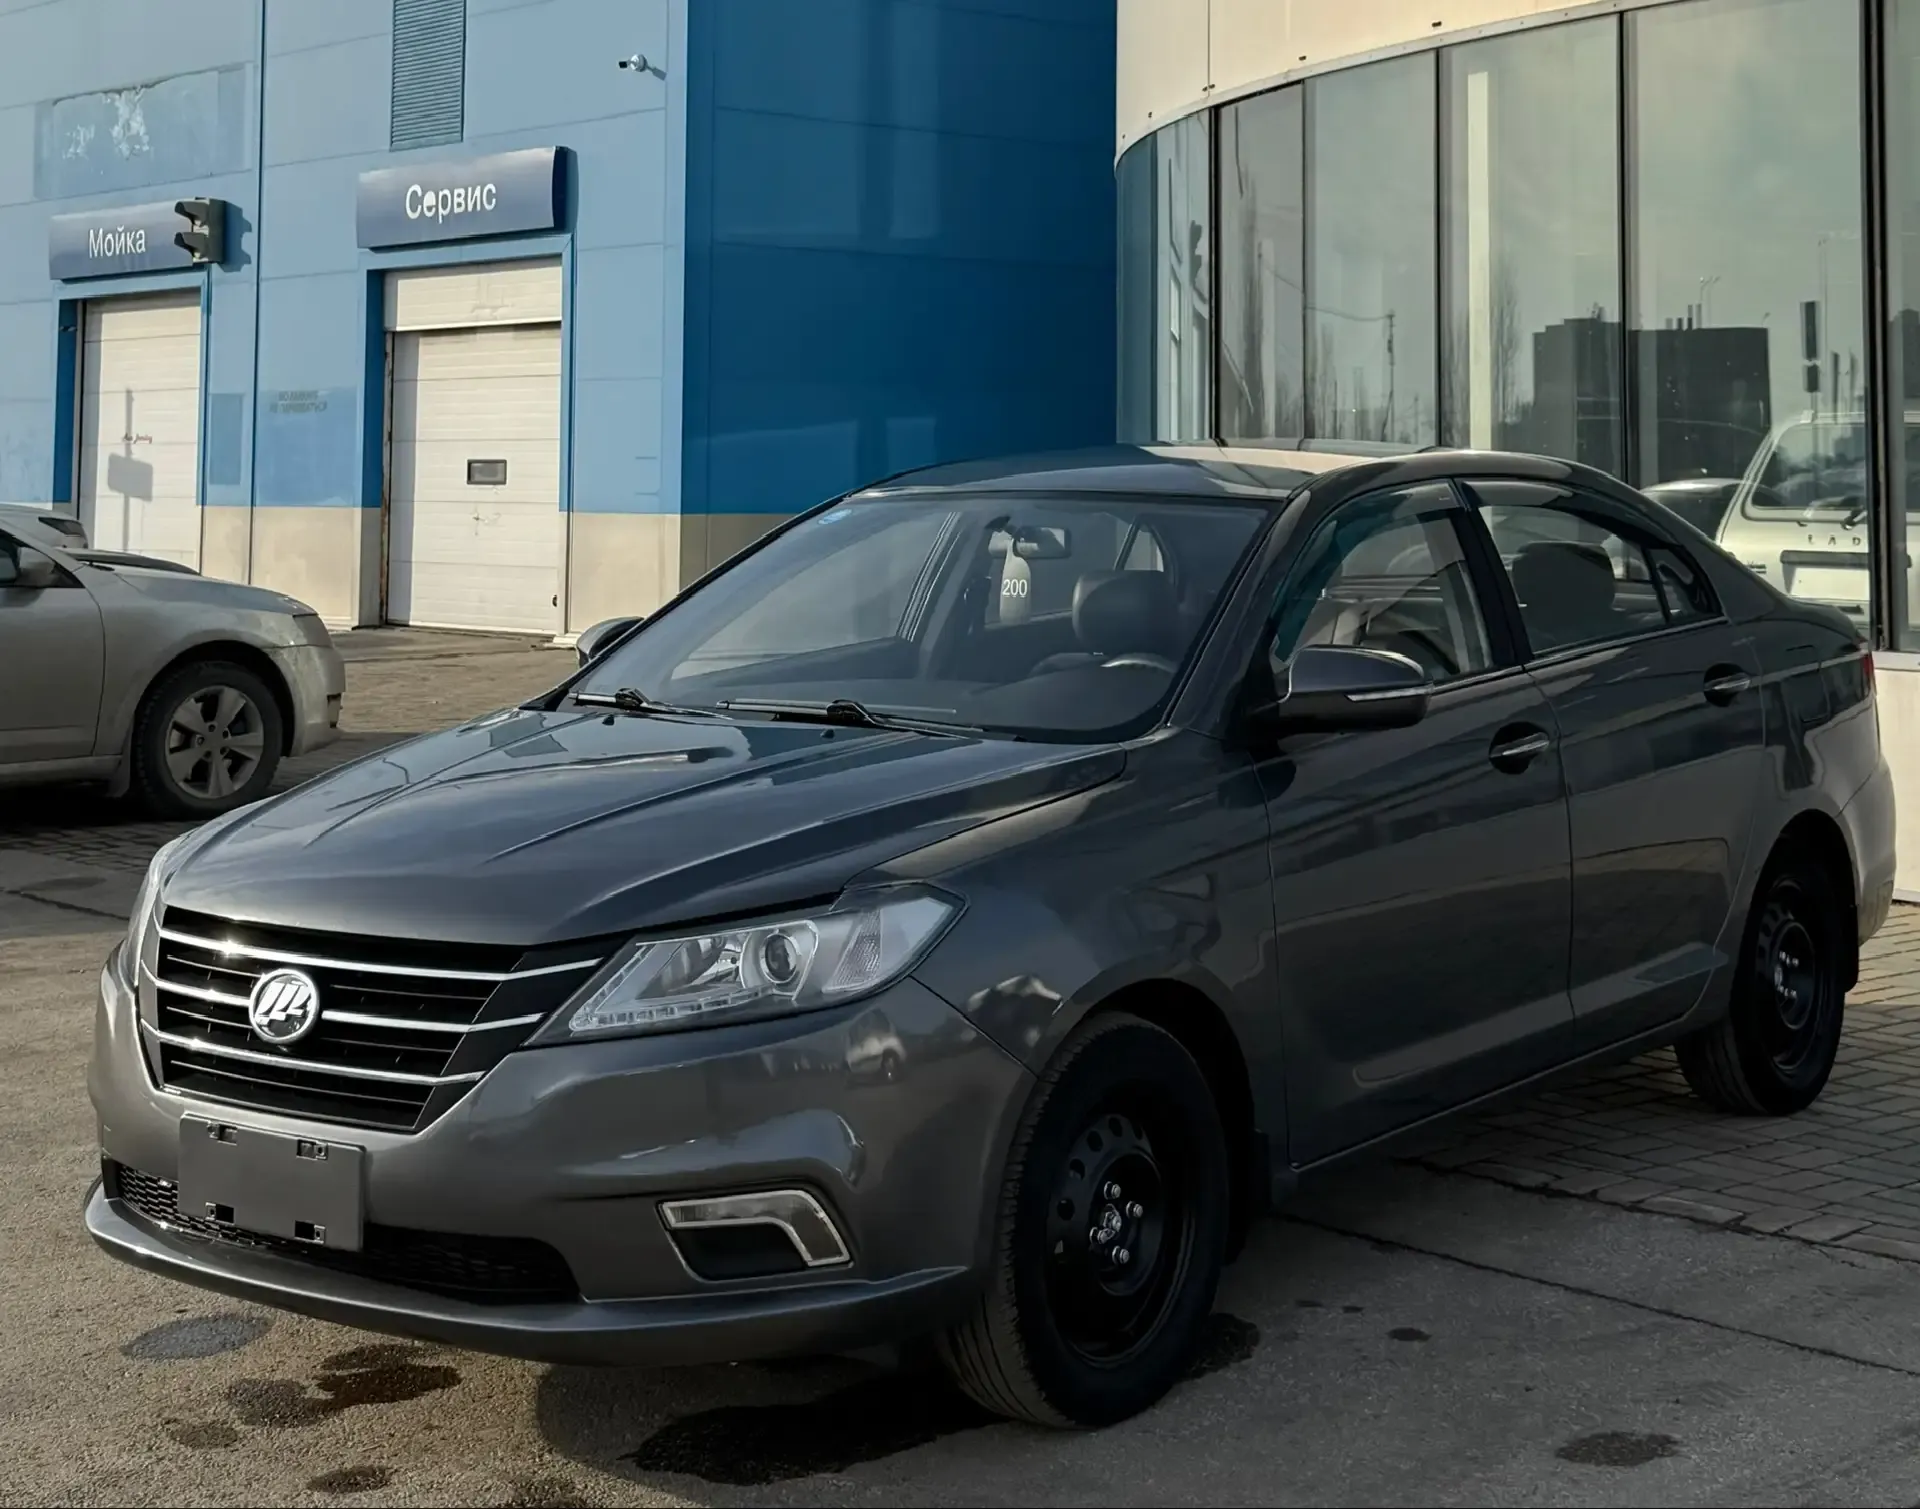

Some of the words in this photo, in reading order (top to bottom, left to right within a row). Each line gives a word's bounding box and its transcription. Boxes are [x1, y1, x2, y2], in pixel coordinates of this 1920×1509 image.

[405, 183, 496, 224] Сервис
[89, 224, 146, 258] Мойка
[1807, 534, 1862, 546] LAD
[1002, 578, 1028, 596] 200
